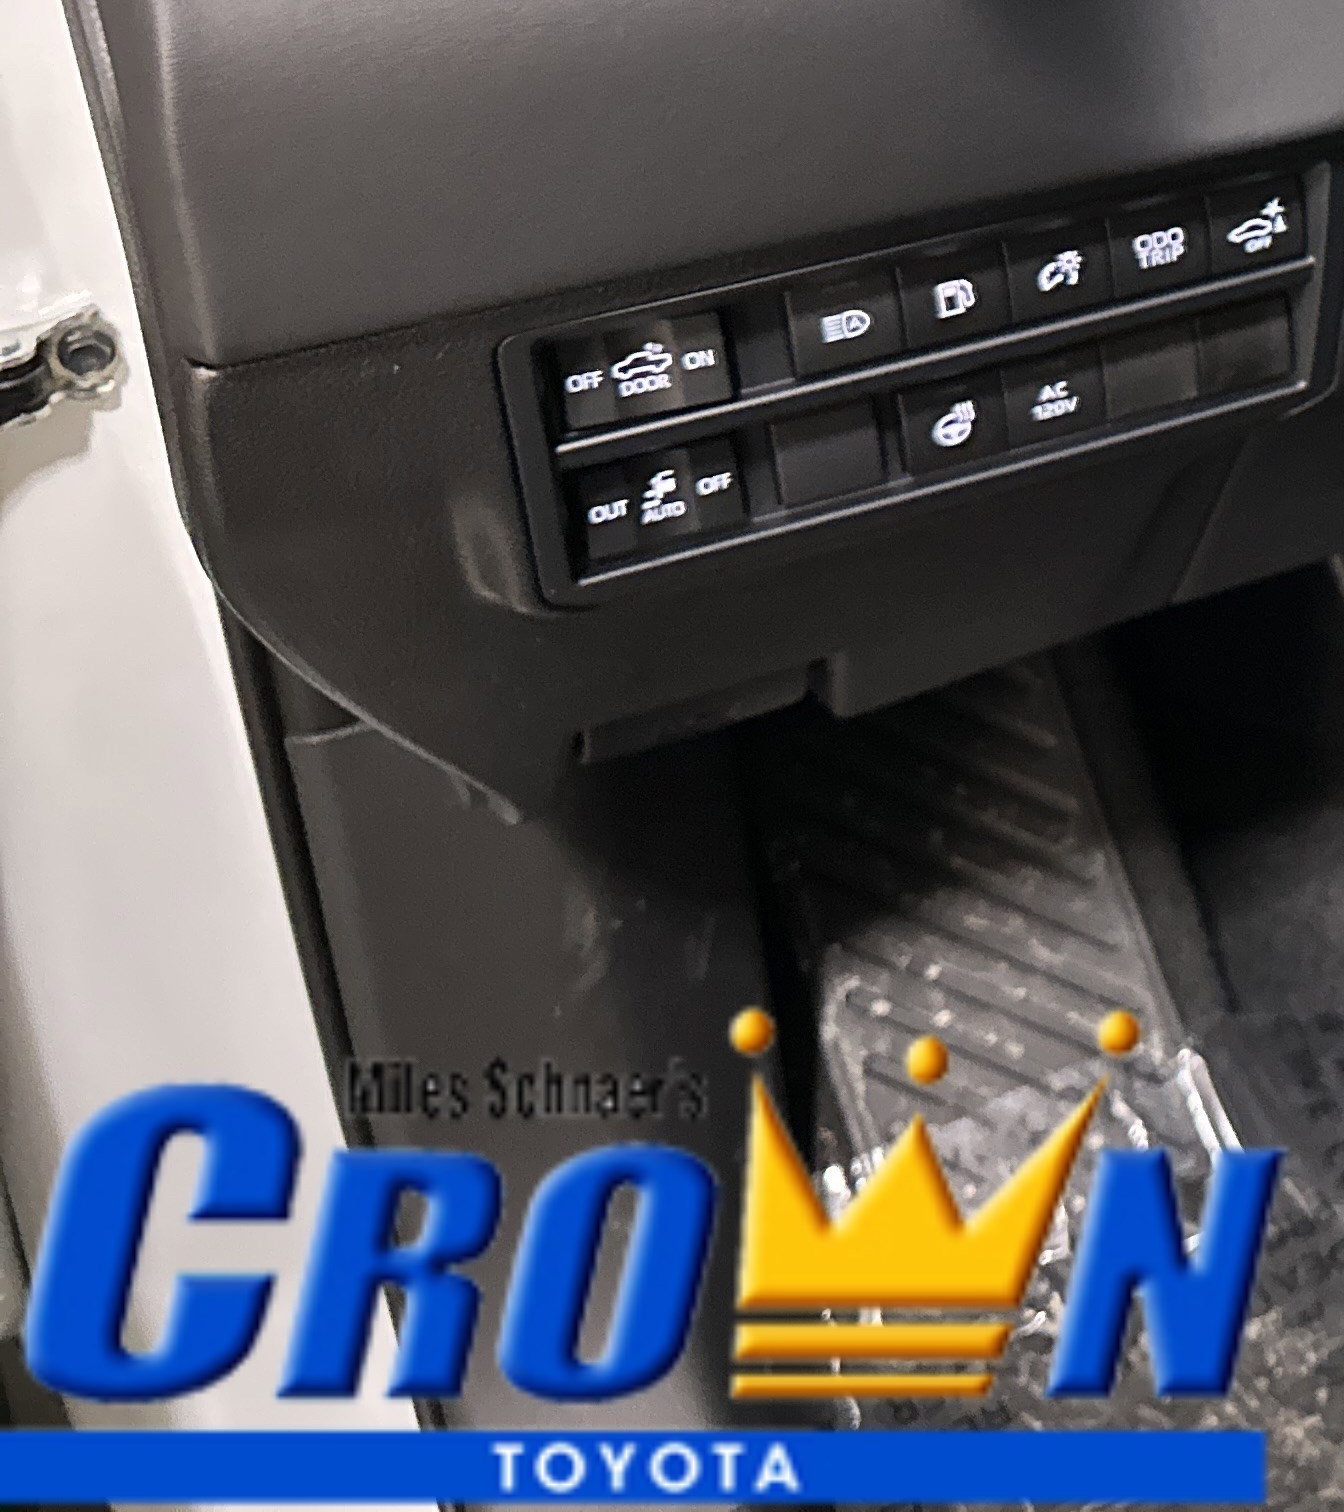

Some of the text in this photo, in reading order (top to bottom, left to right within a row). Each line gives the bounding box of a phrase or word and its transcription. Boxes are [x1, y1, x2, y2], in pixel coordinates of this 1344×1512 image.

[1133, 227, 1185, 255] ODO
[1137, 244, 1186, 270] TRIP
[681, 348, 716, 370] ON
[564, 369, 604, 394] OFF
[617, 374, 671, 398] DOOR
[1037, 380, 1070, 403] AC
[1030, 395, 1080, 422] 120V
[696, 471, 733, 497] OFF
[587, 498, 630, 525] OUT
[640, 499, 687, 526] AUTO
